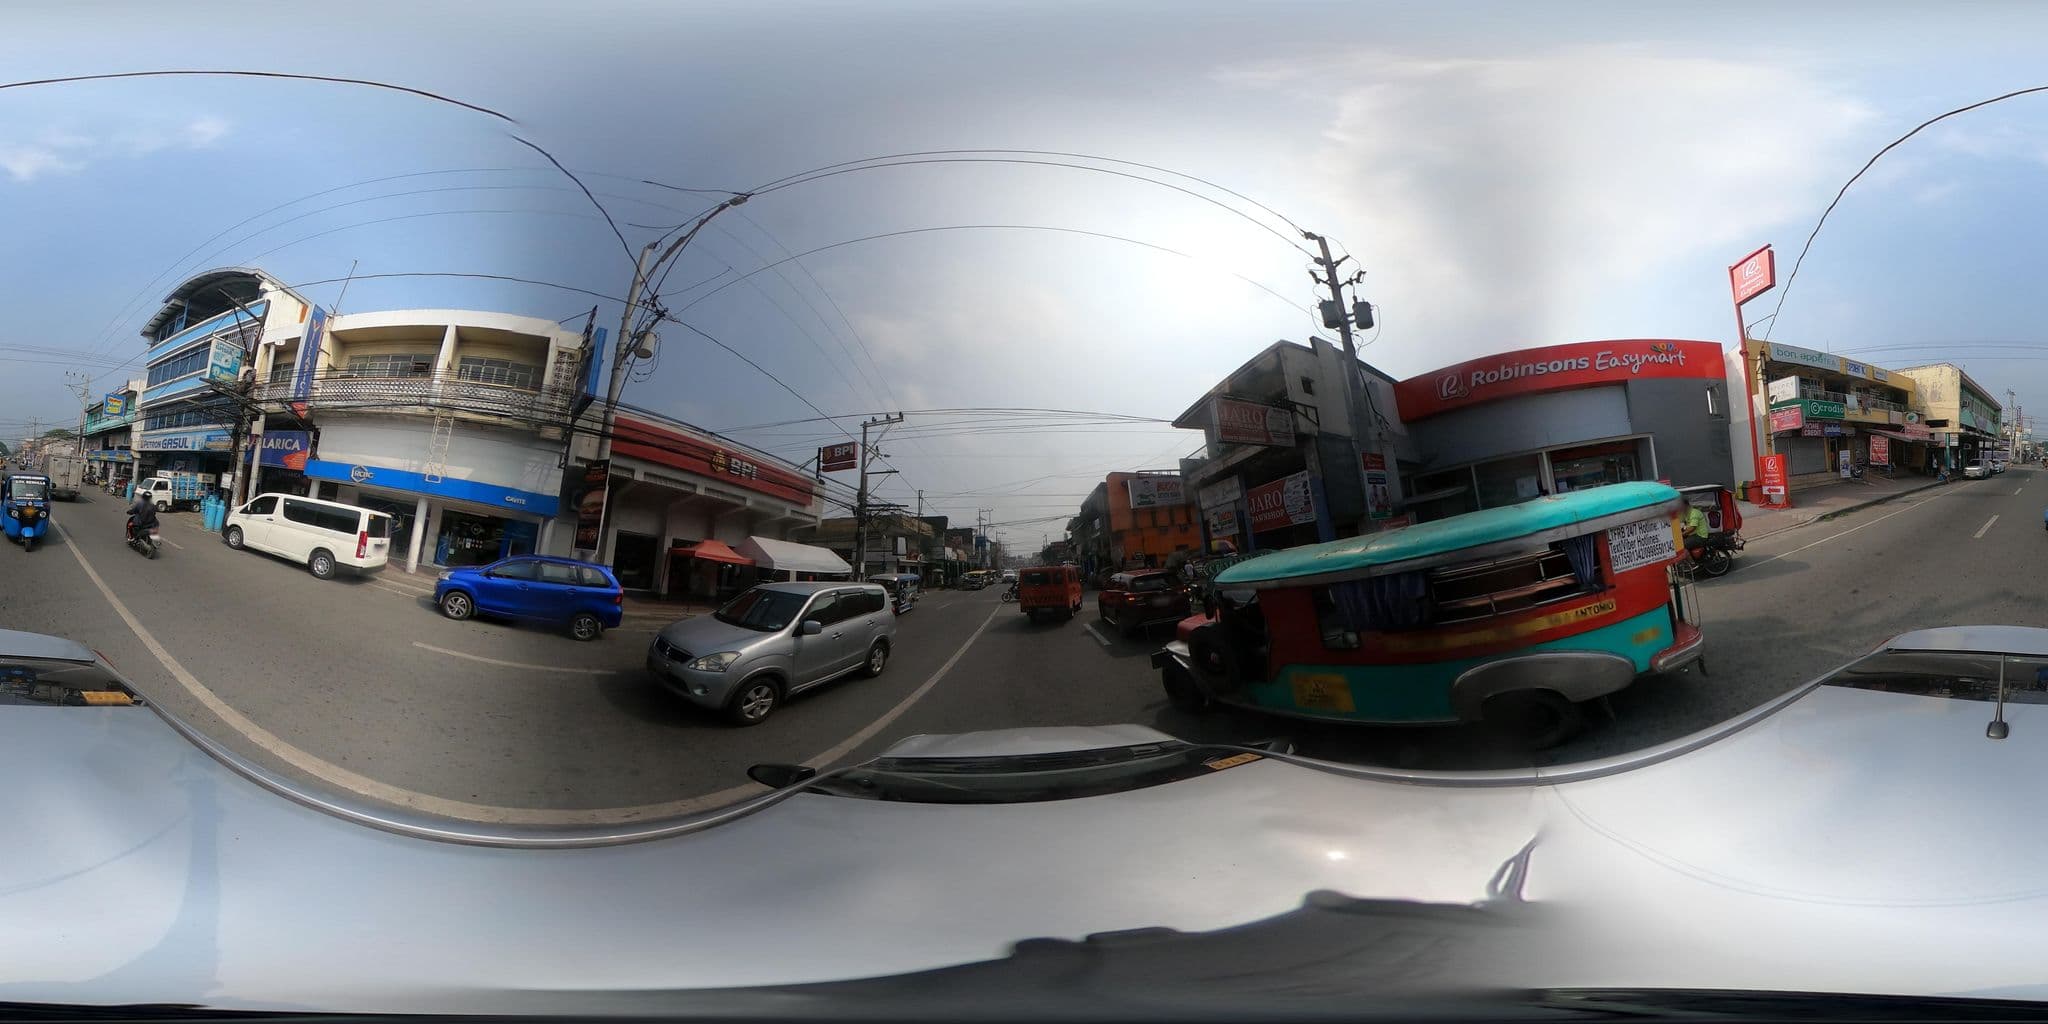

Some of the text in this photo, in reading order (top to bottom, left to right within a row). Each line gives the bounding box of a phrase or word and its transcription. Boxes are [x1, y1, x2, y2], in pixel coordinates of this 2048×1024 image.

[1776, 347, 1797, 359] bon
[1471, 350, 1686, 387] Robinsons Easymart
[1222, 404, 1263, 424] JARO
[161, 437, 189, 449] GASUL
[834, 446, 855, 457] BPI
[730, 457, 758, 480] BPI
[505, 495, 527, 505] CAVITE
[1249, 489, 1283, 514] JARO
[1626, 523, 1637, 538] 24/7
[1575, 601, 1614, 617] ANTONIO
